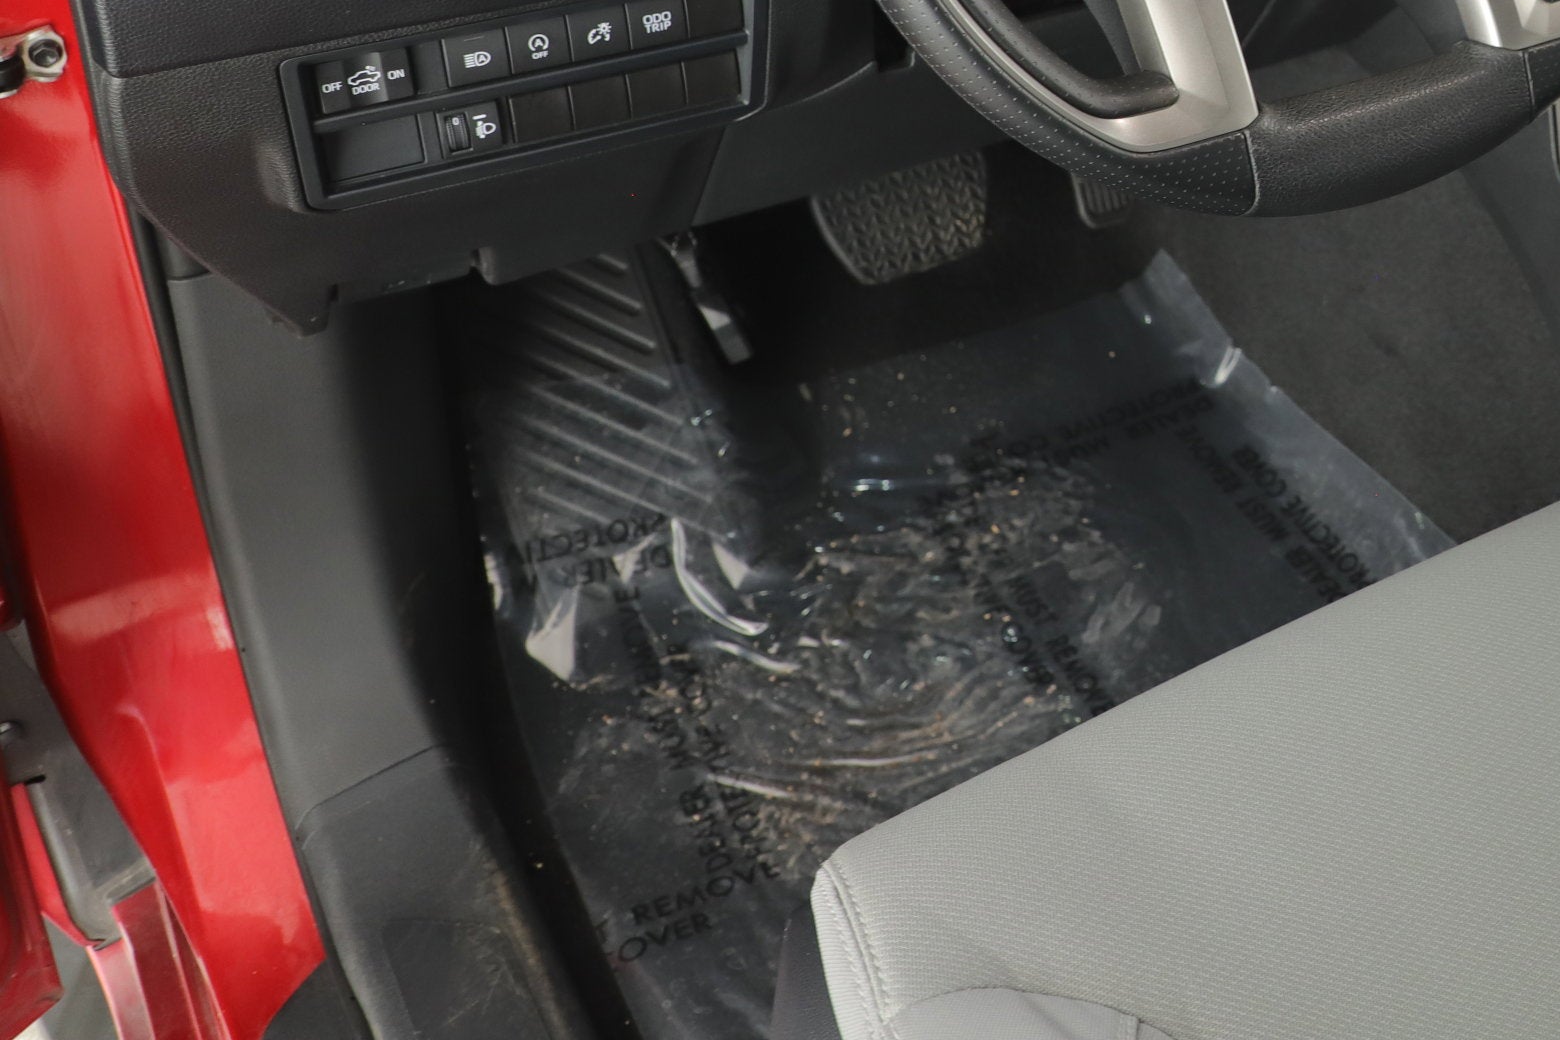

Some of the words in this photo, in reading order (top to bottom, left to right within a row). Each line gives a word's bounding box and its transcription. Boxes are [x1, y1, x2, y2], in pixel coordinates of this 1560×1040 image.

[642, 10, 672, 26] ODO
[646, 20, 673, 35] TRIP
[529, 50, 549, 61] OFF
[387, 68, 406, 81] ON
[321, 81, 343, 95] OFF
[351, 82, 381, 96] DOOR
[451, 117, 461, 128] 0
[630, 861, 780, 925] REMOVE
[608, 912, 713, 964] OVER
